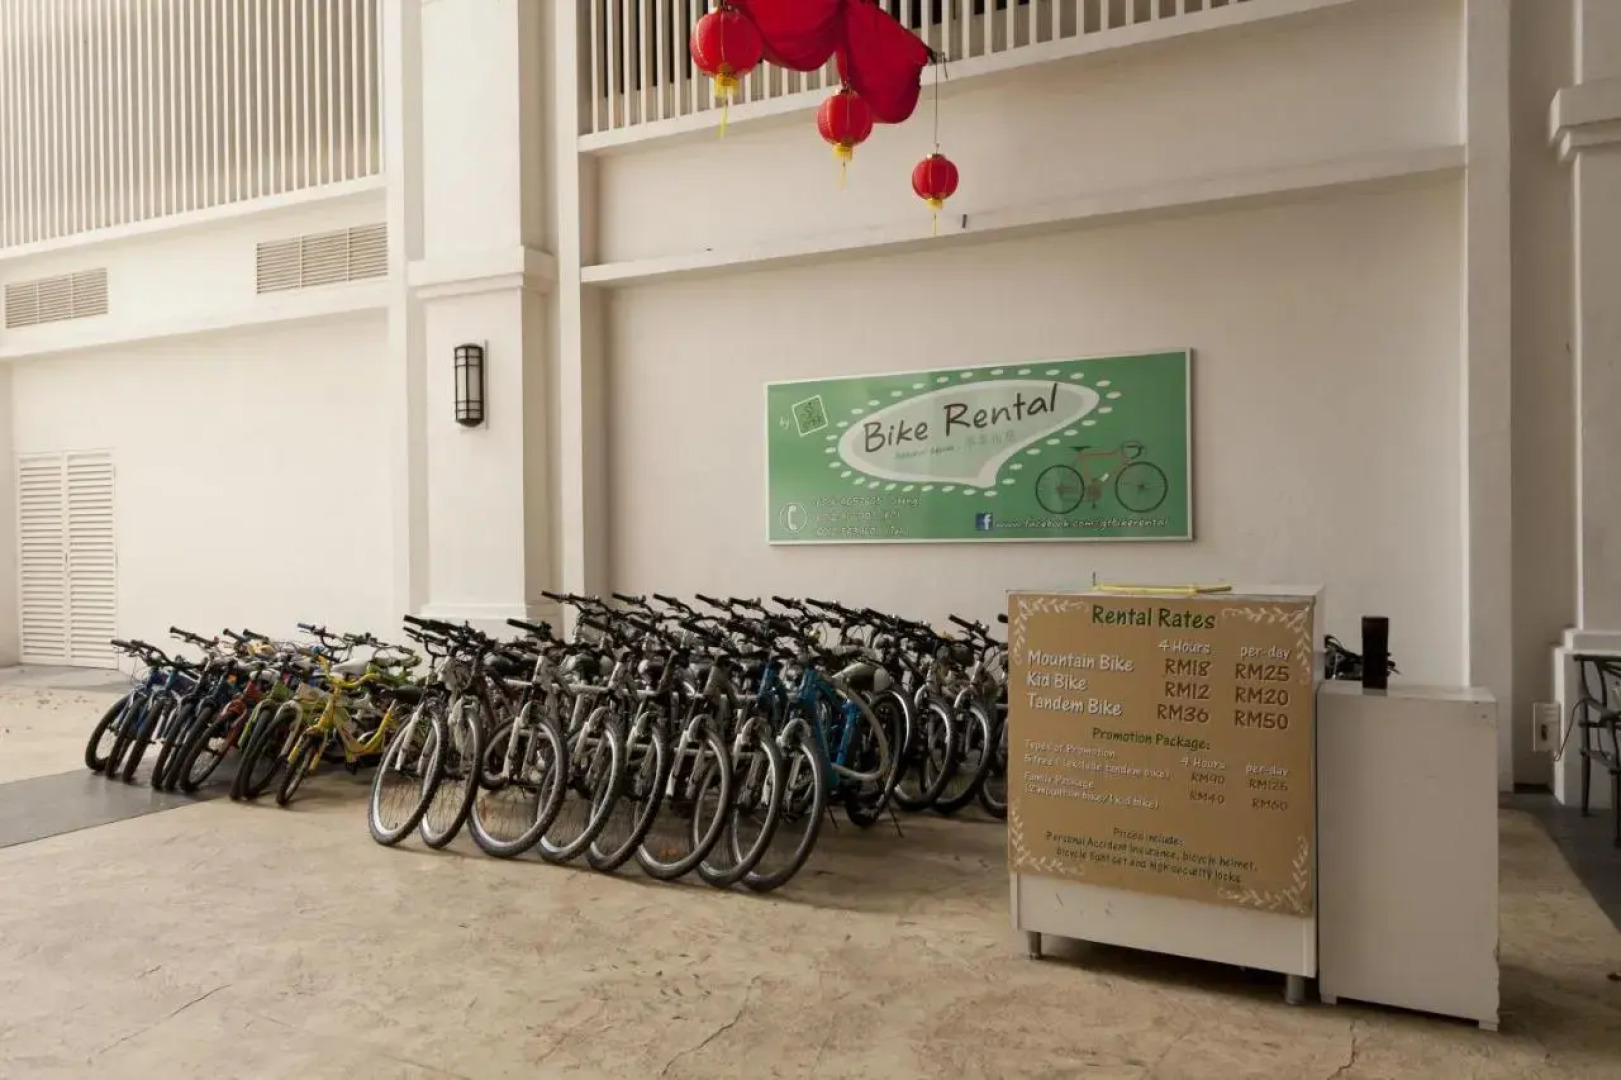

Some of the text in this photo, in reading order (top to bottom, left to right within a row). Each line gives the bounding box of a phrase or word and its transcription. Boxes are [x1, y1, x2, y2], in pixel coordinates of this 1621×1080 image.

[863, 419, 928, 453] Bike
[943, 382, 1058, 437] Rental
[1092, 604, 1216, 629] Rental Rates
[1158, 639, 1170, 652] 4
[1172, 640, 1212, 655] Hours
[1027, 649, 1290, 682] Mountain Bike RM18 RM25
[1026, 670, 1289, 706] Kid Bike RM12 RM20
[1027, 692, 1289, 730] Tandem Bike RM36 RM50
[1092, 727, 1211, 752] Promotion Package:
[1180, 755, 1189, 767] 4
[1192, 756, 1227, 771] Hours
[1191, 771, 1226, 786] RM90
[1190, 789, 1226, 805] RM40
